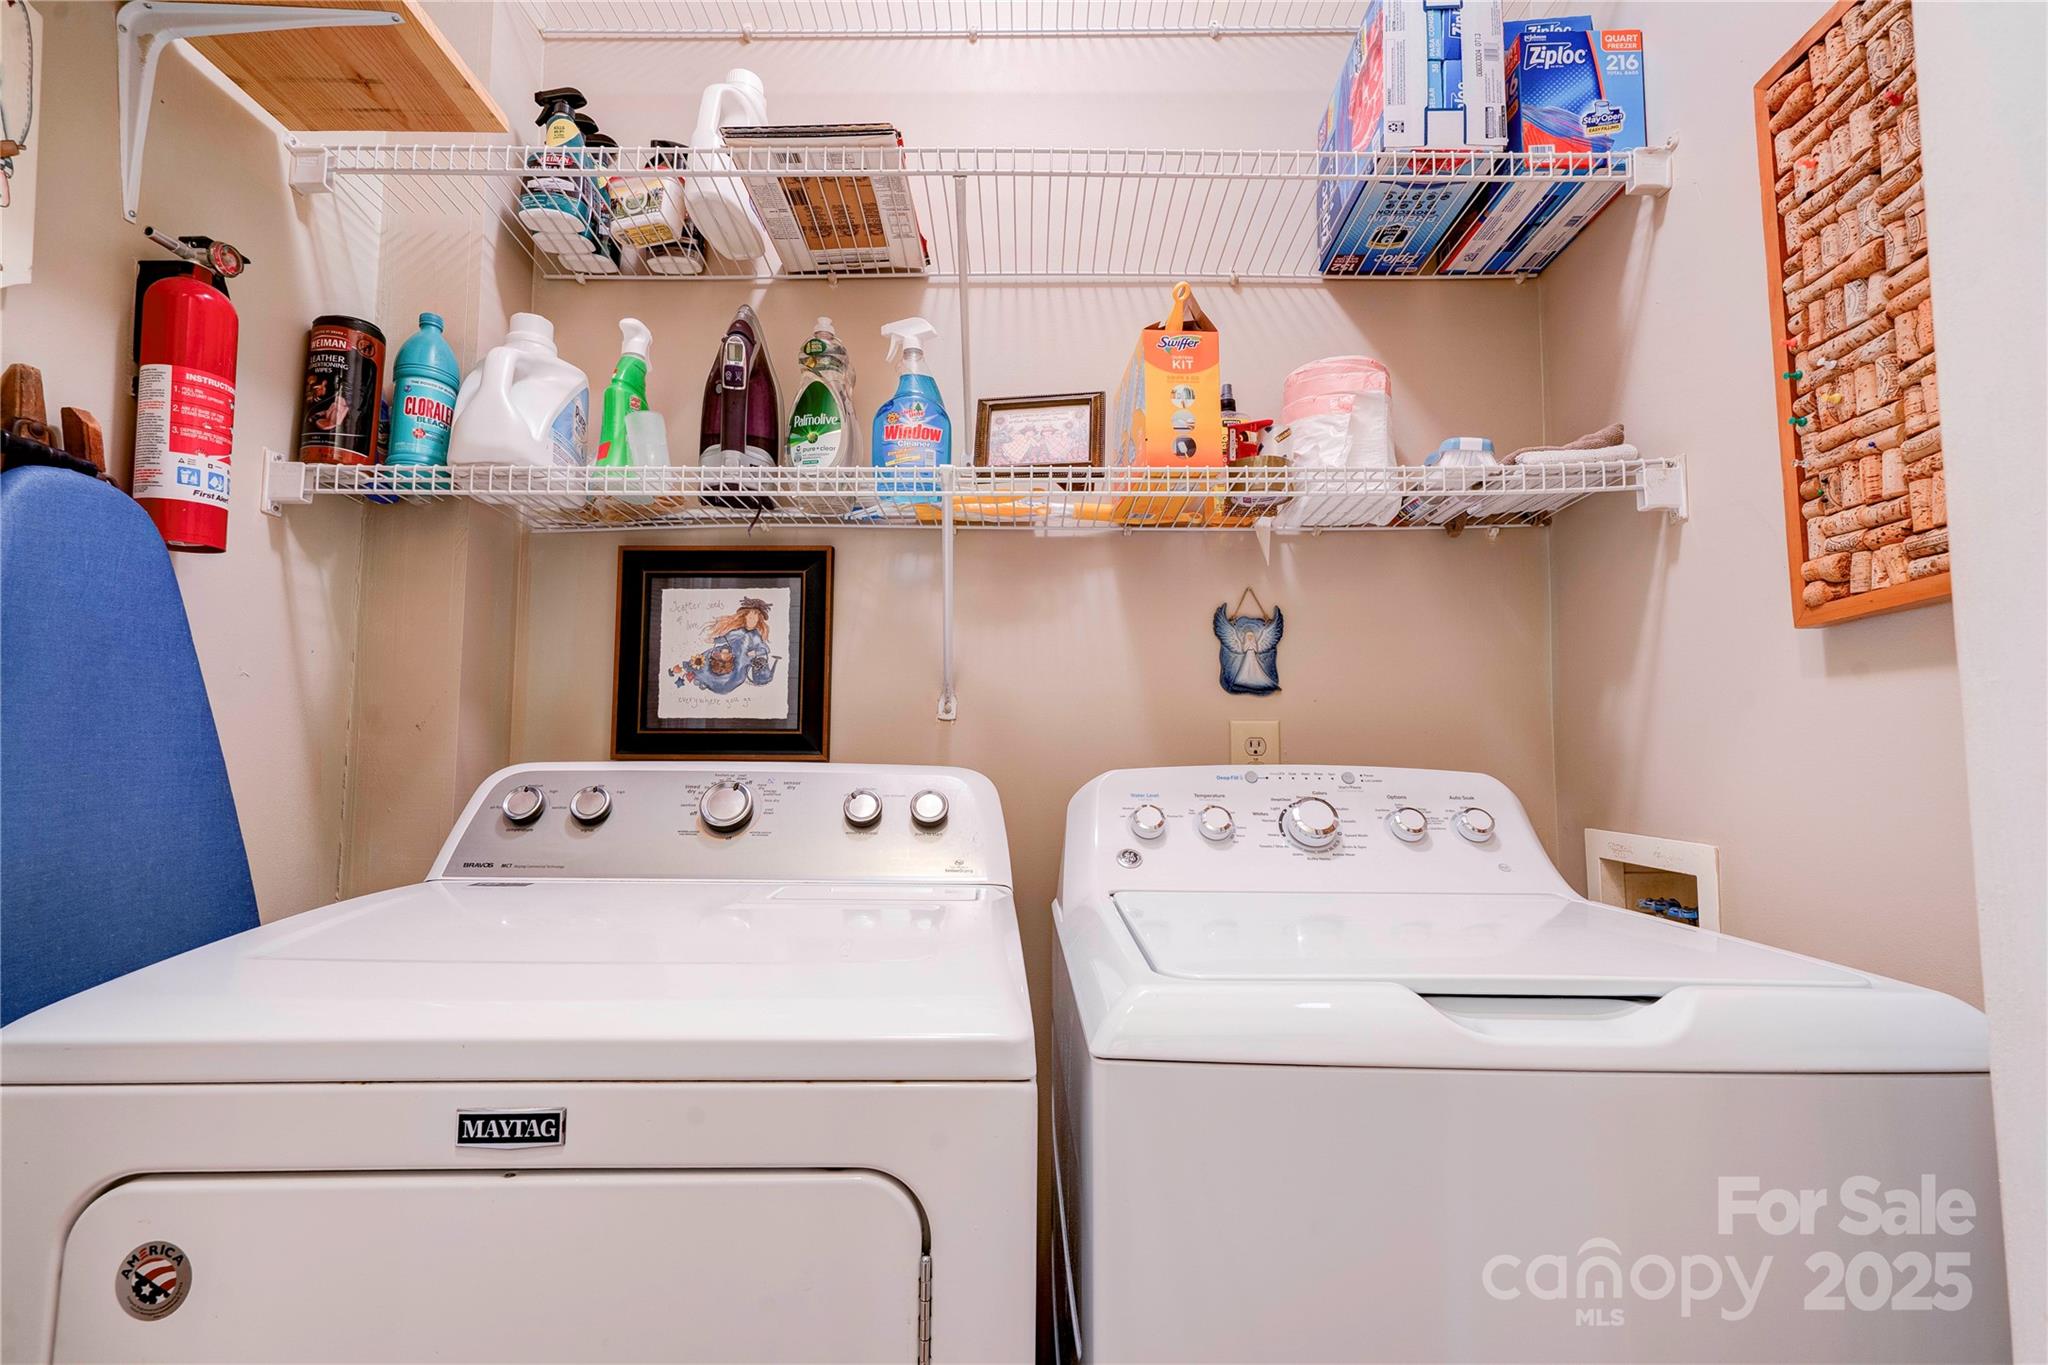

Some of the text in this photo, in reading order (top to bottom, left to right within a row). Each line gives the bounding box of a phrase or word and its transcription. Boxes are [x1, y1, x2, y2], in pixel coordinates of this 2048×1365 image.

[1605, 34, 1638, 42] QUART
[1530, 46, 1586, 69] Ziploc
[1606, 55, 1639, 70] 216
[1158, 336, 1199, 350] Swiffer
[1172, 360, 1193, 369] KIT
[794, 413, 839, 428] Palmolive
[885, 424, 942, 442] Window
[193, 490, 215, 500] First
[462, 1119, 557, 1138] MAYTAG
[122, 1244, 184, 1280] AMERICA
